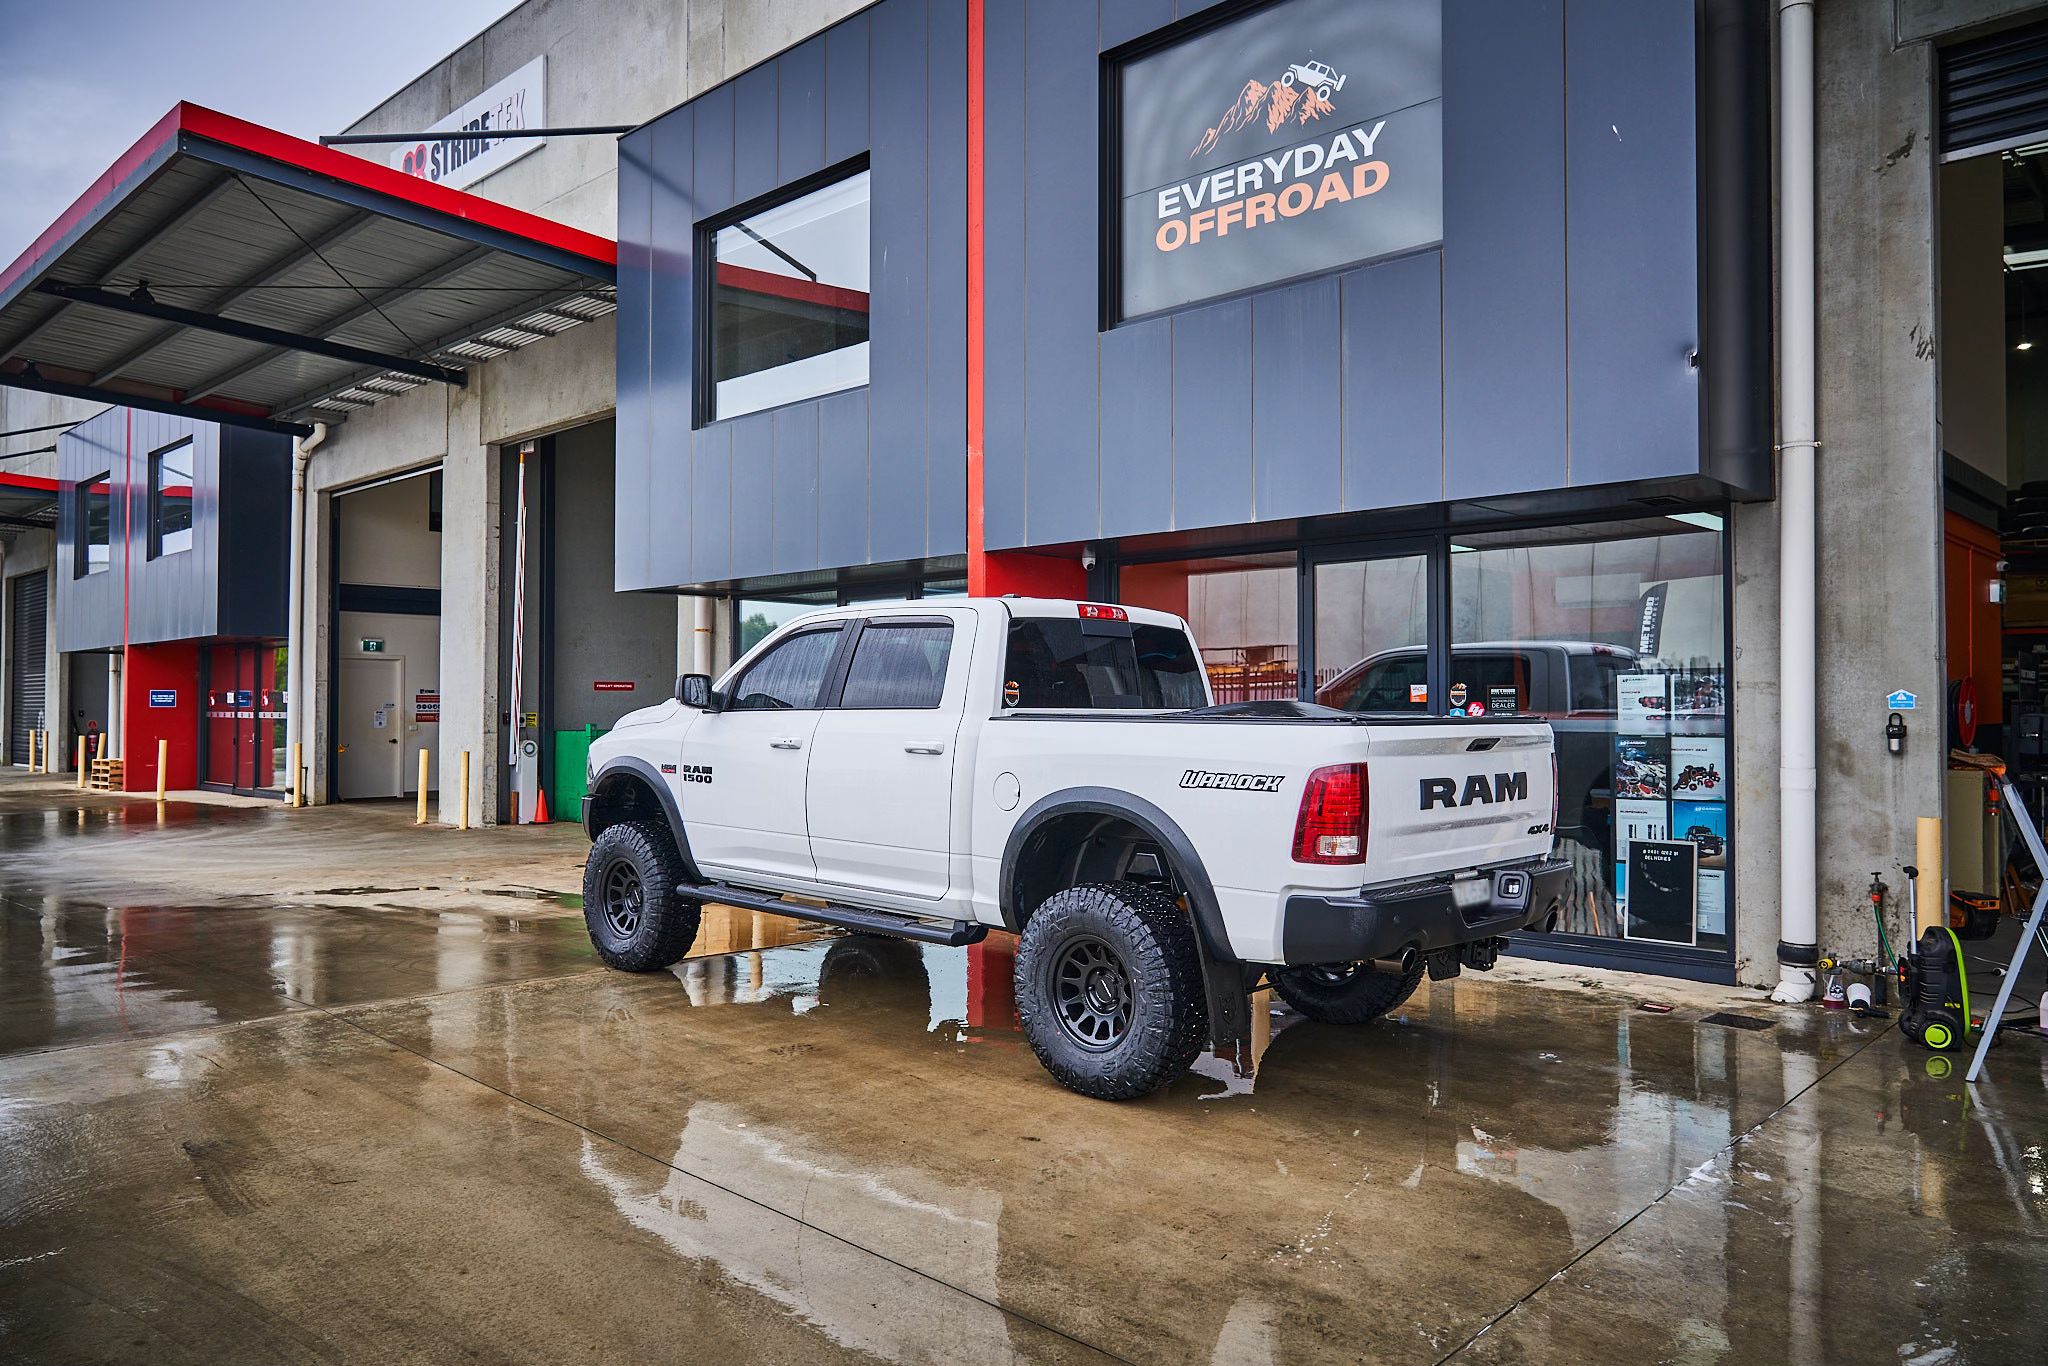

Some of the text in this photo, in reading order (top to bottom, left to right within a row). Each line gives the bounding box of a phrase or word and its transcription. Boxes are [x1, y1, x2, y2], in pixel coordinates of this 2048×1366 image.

[1158, 121, 1386, 219] EVERYDAY
[1155, 160, 1390, 252] OFFROAD
[1639, 596, 1655, 654] METHOD
[1650, 596, 1660, 630] WHEELS
[683, 765, 713, 774] RAM
[683, 774, 713, 784] 1500
[1179, 769, 1286, 793] WARLOCK
[1419, 771, 1528, 811] RAM
